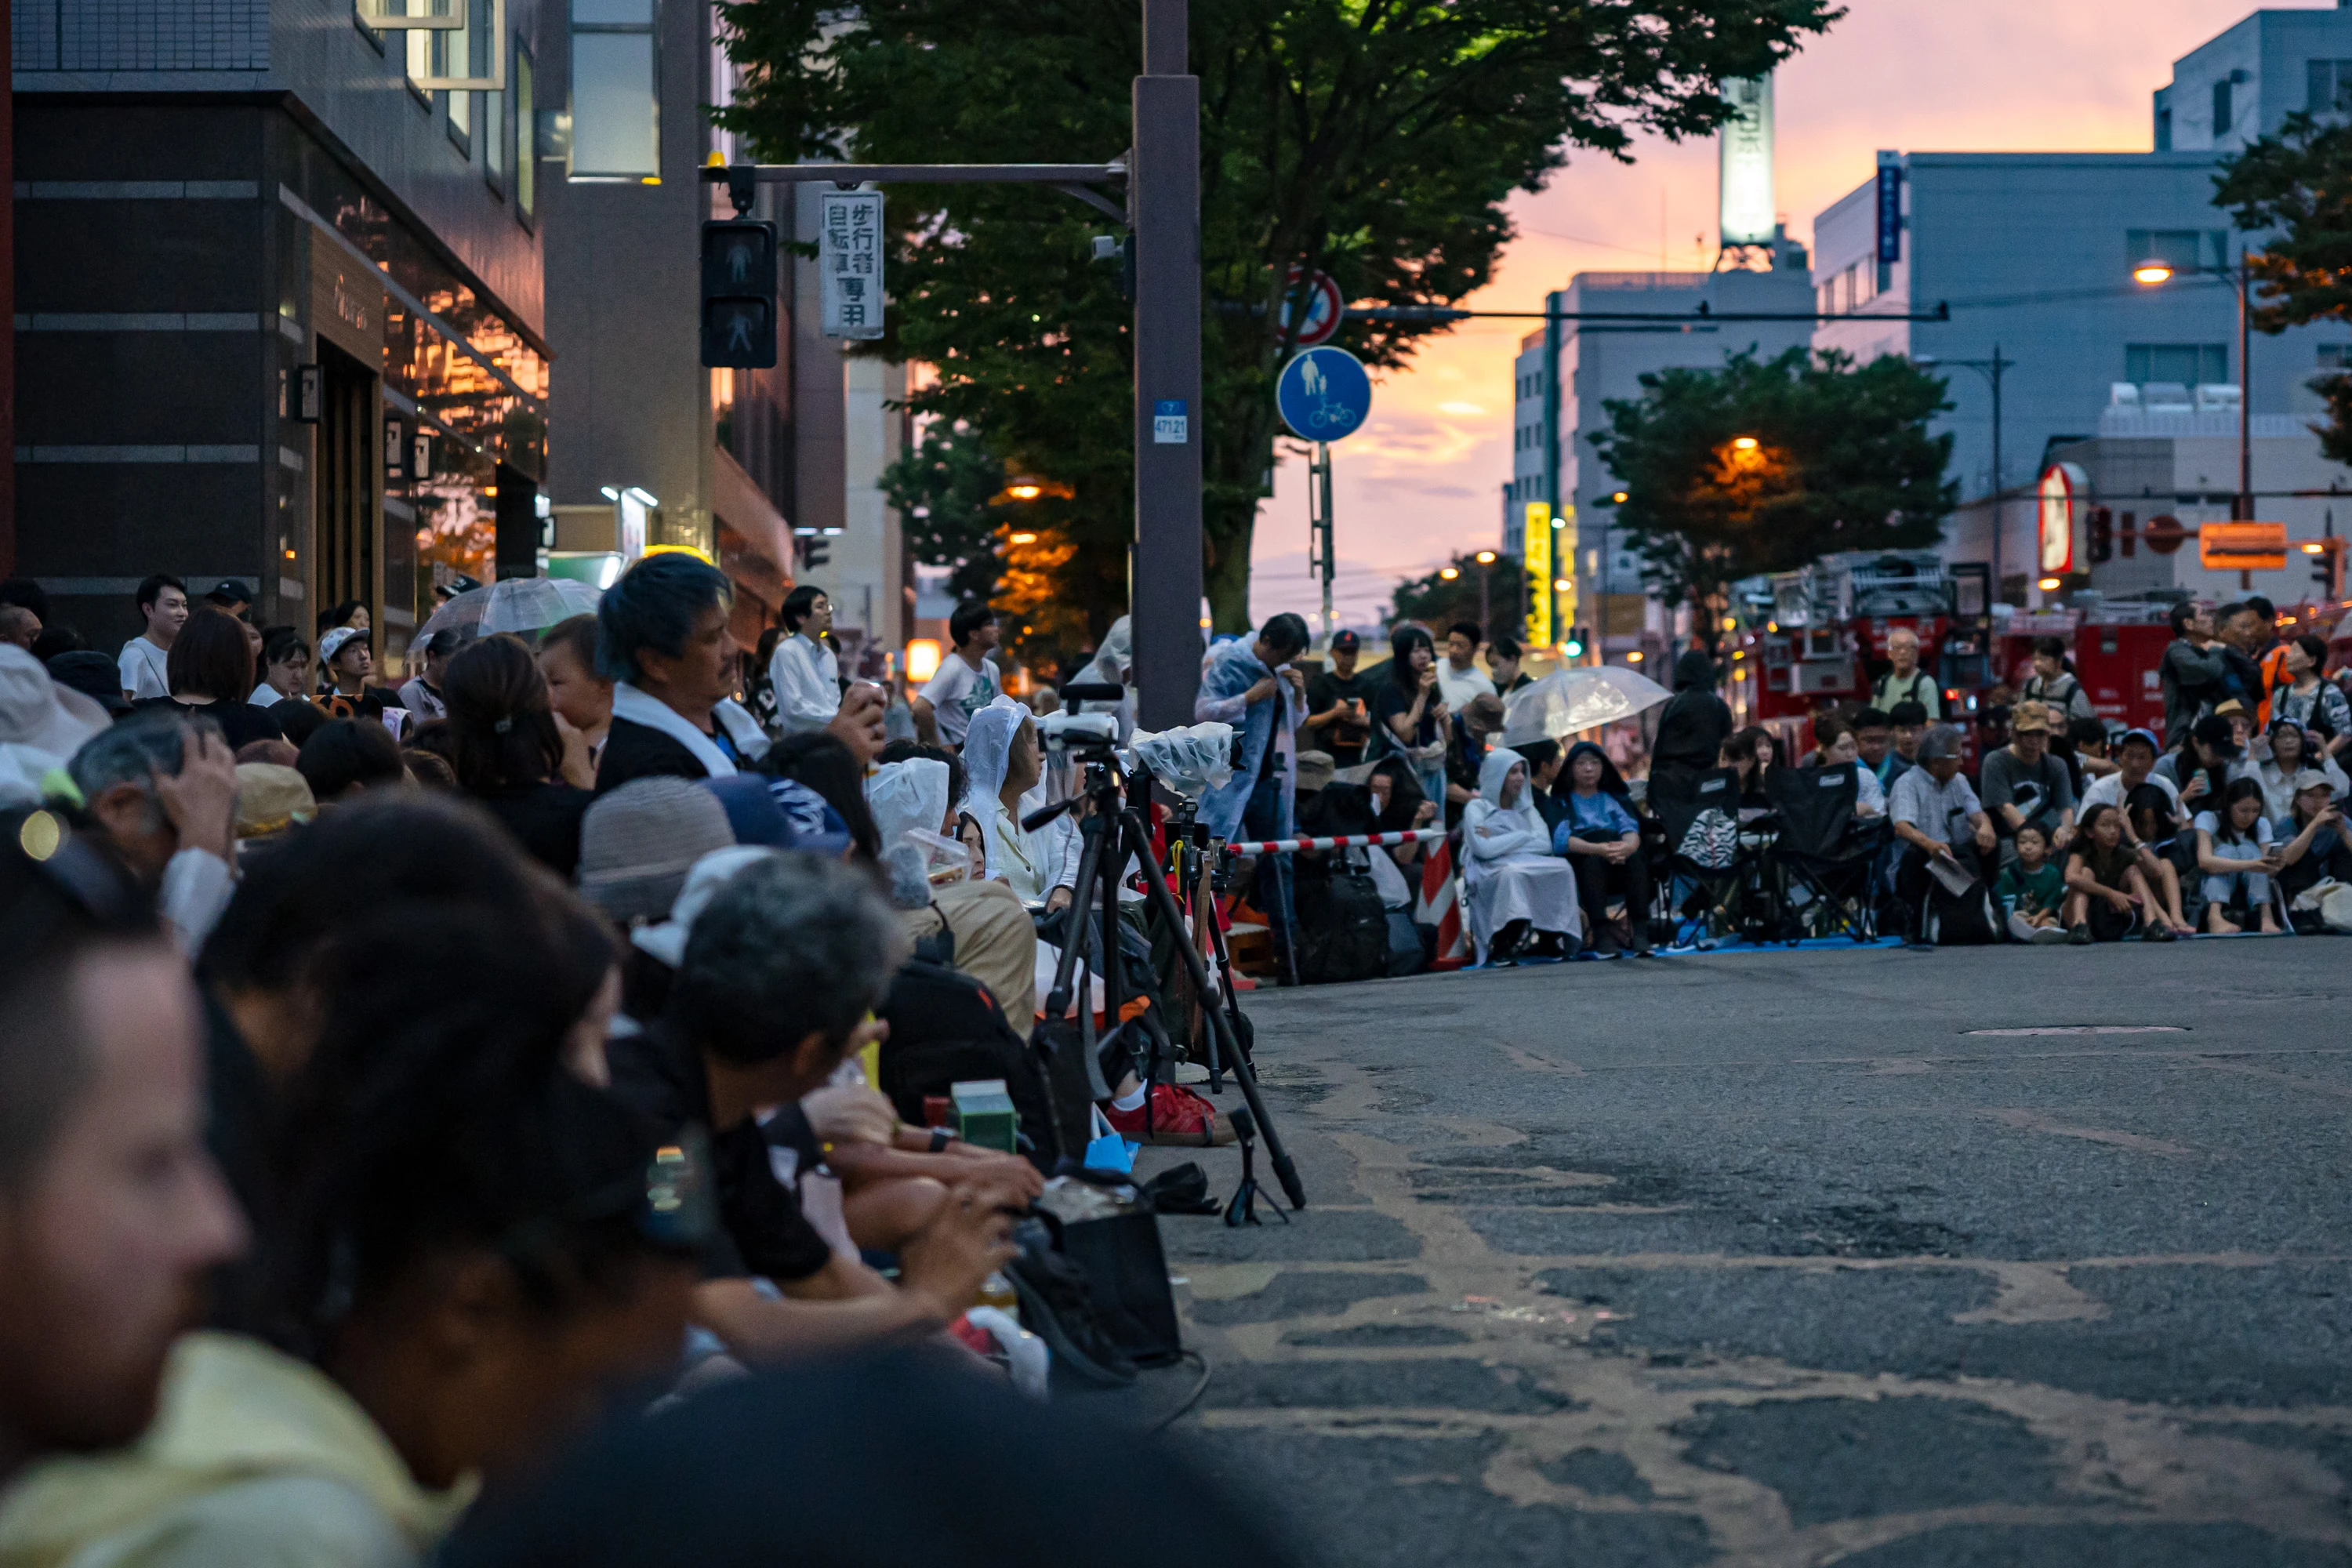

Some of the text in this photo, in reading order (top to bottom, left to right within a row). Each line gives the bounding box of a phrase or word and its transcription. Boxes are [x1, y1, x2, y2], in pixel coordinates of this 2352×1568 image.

[852, 204, 874, 274] 歩行者
[837, 277, 866, 325] 専用
